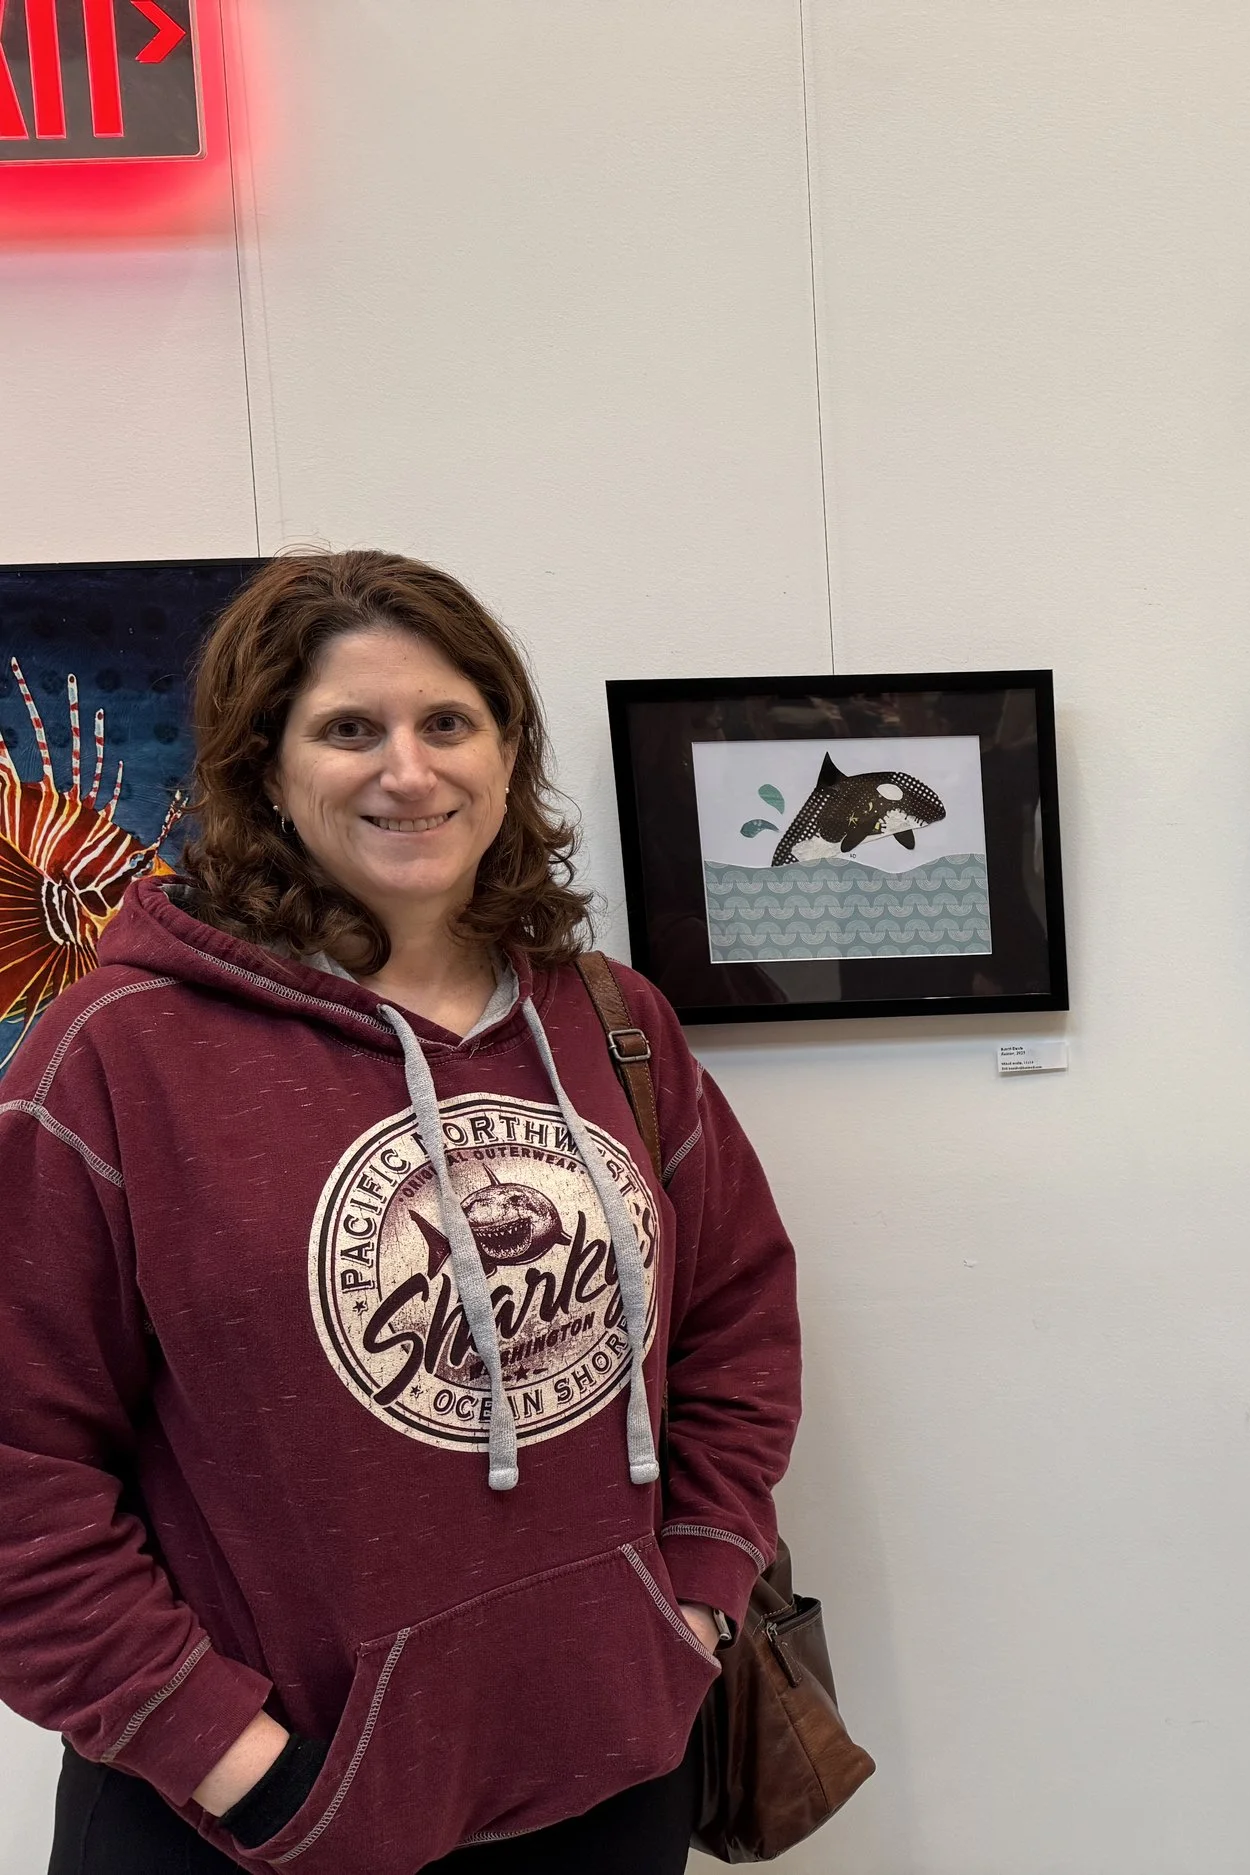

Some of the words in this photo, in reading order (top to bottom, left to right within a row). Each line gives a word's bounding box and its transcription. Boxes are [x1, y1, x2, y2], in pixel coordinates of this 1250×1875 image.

[341, 1148, 411, 1293] PACIFIC
[411, 1115, 639, 1196] ORTHWST
[402, 1151, 468, 1197] ORIGIAL
[474, 1146, 577, 1173] OUTERWEAR
[470, 1312, 595, 1380] WSHINGTON
